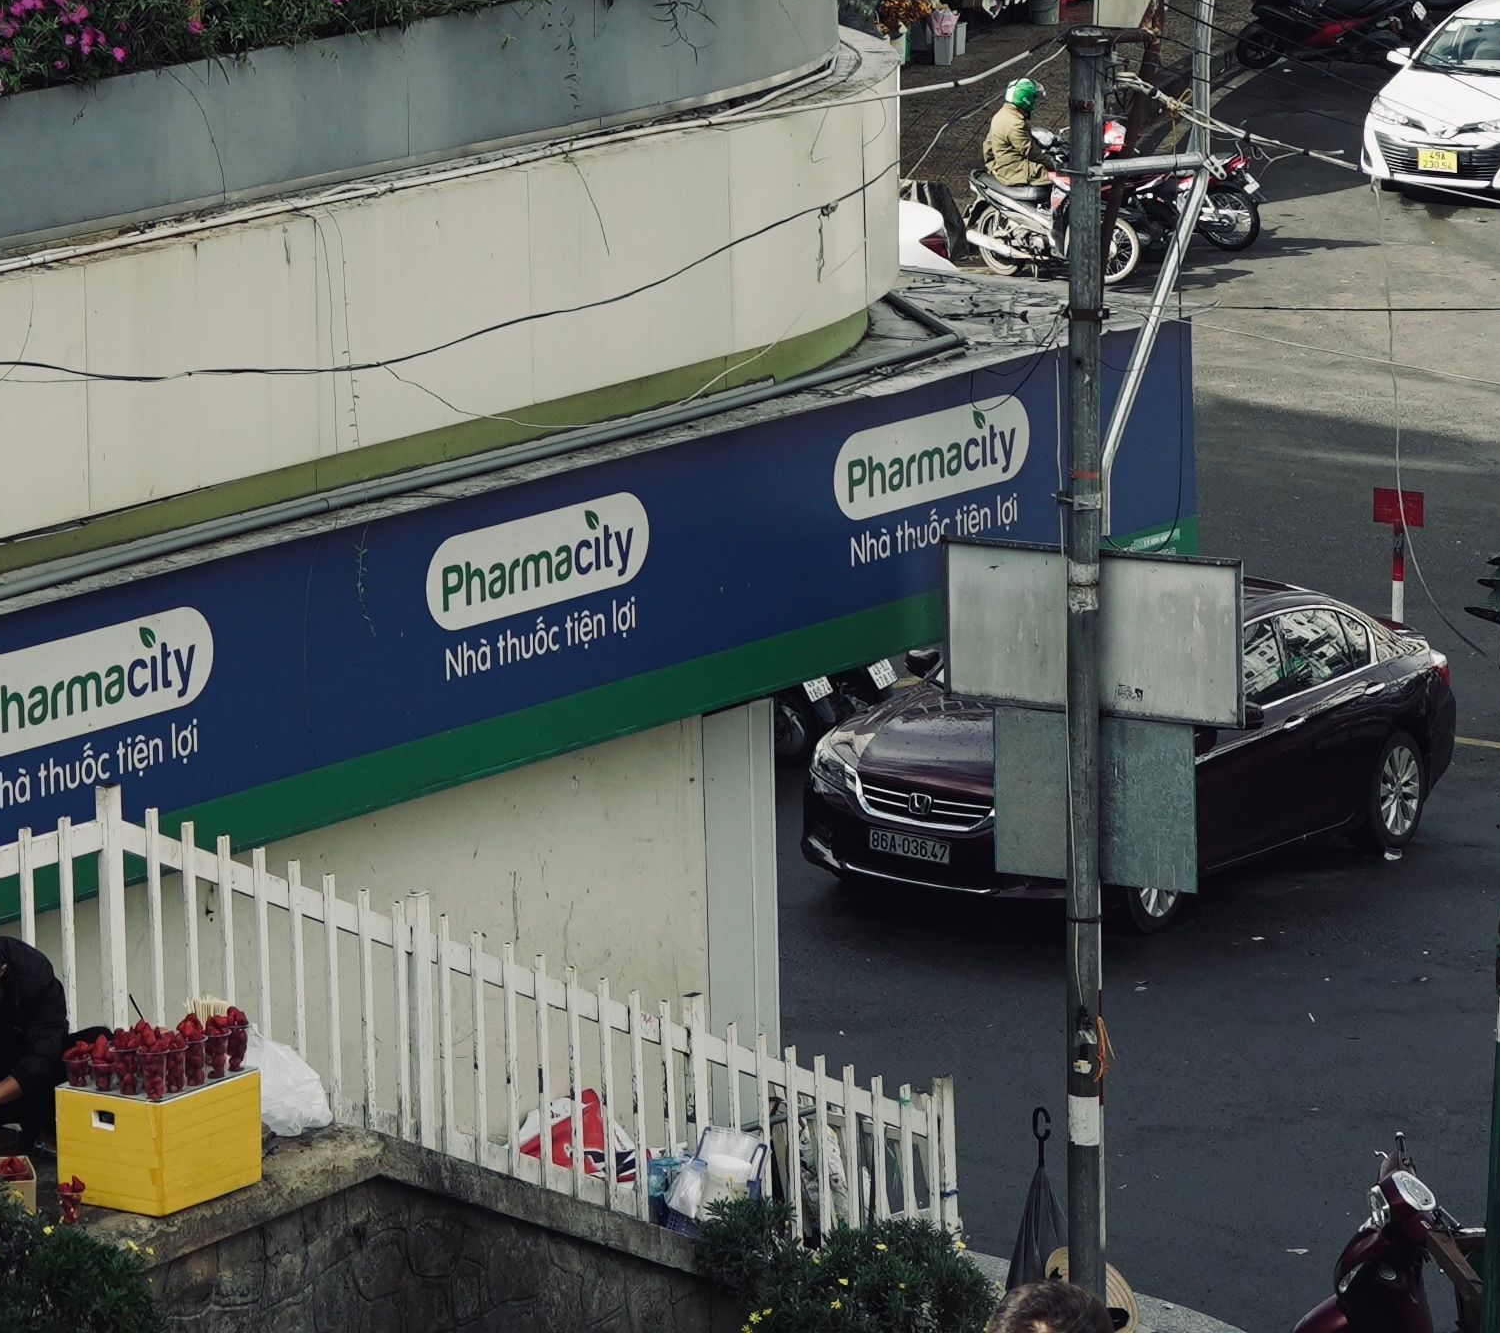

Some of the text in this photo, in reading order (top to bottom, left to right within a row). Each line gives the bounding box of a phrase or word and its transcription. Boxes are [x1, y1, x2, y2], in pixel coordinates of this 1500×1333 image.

[1430, 150, 1446, 160] 49A
[847, 411, 1017, 504] Pharmacity
[440, 510, 635, 613] Pharmacity
[849, 528, 892, 567] Nhà
[895, 507, 952, 554] thuốc
[996, 492, 1019, 531] lợi
[444, 596, 637, 682] Nhà thuốc tiện lợi
[38, 742, 111, 798] thuốc
[116, 734, 164, 777] tiện
[171, 718, 199, 764] lợi
[869, 830, 949, 863] 86A-036.47
